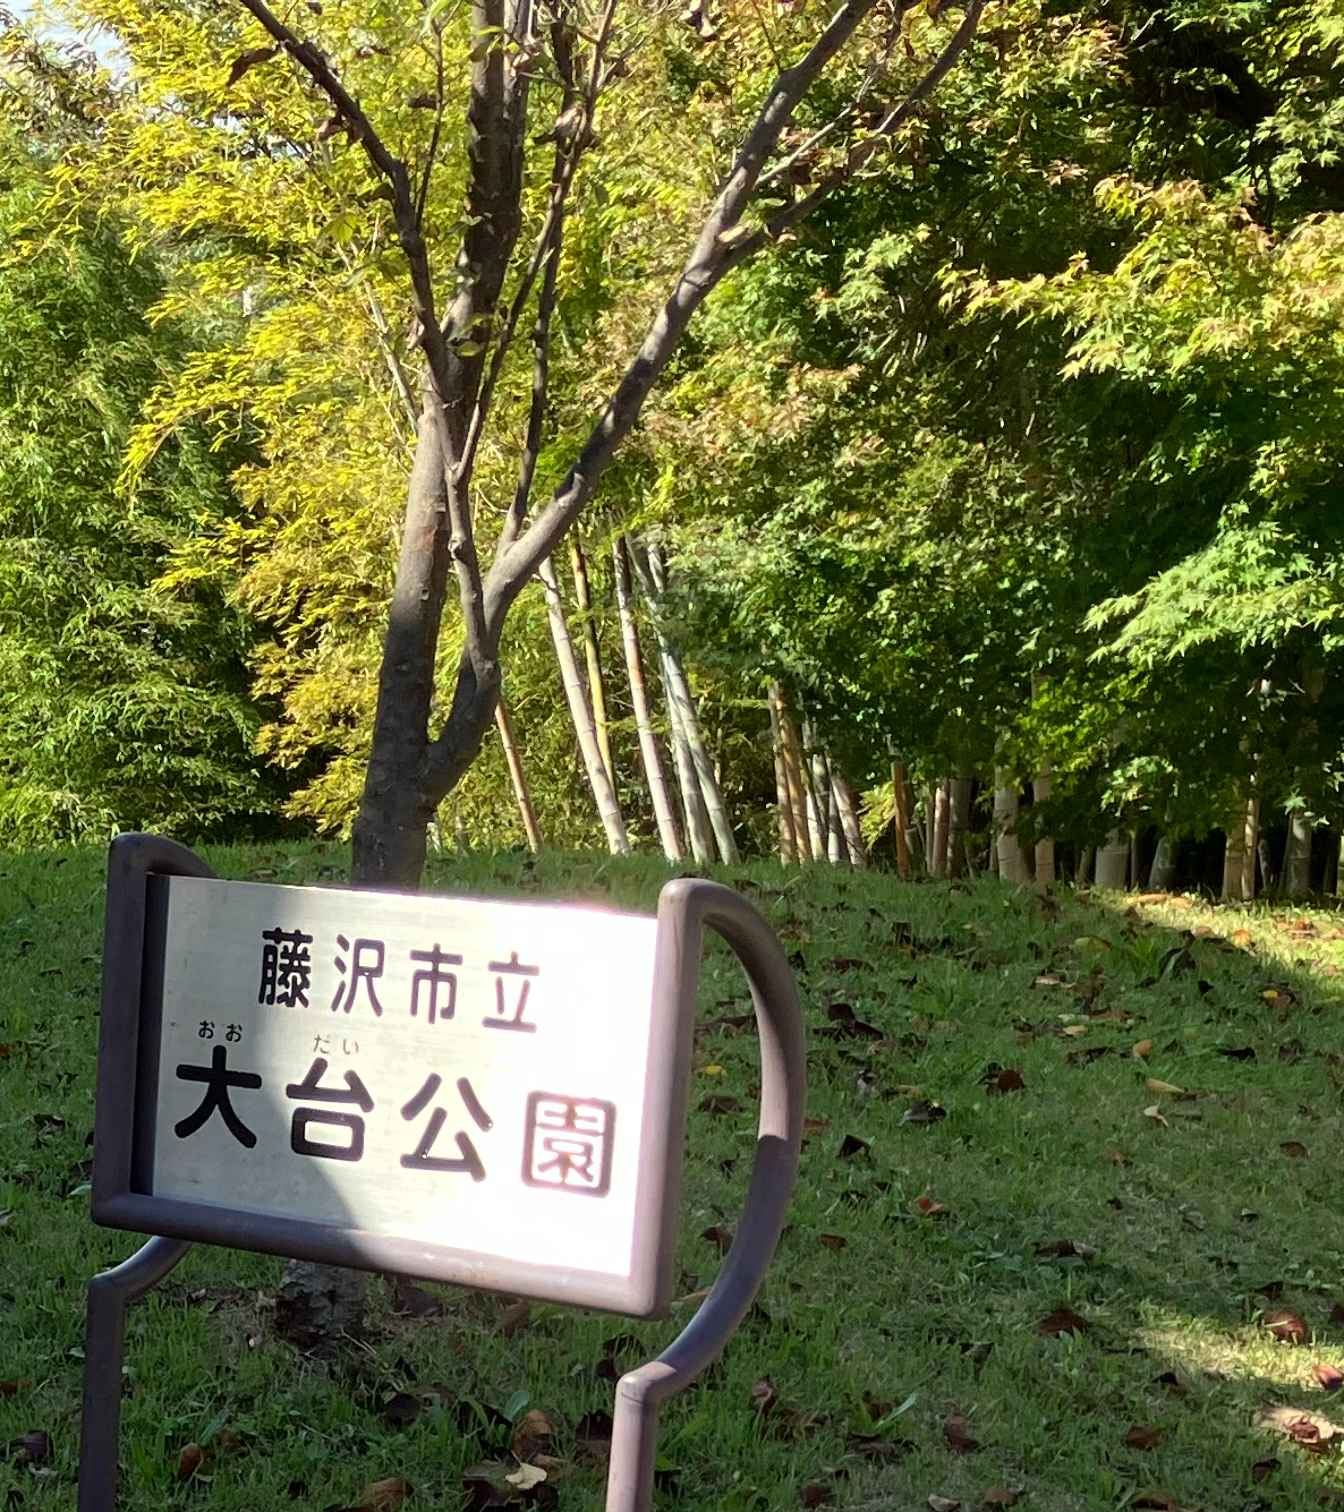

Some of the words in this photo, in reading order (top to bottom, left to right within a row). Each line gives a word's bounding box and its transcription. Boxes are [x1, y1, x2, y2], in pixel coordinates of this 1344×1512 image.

[258, 926, 540, 1034] 藤沢市立
[198, 1020, 243, 1043] おお
[313, 1034, 360, 1055] だい
[174, 1044, 617, 1199] 大台公園
